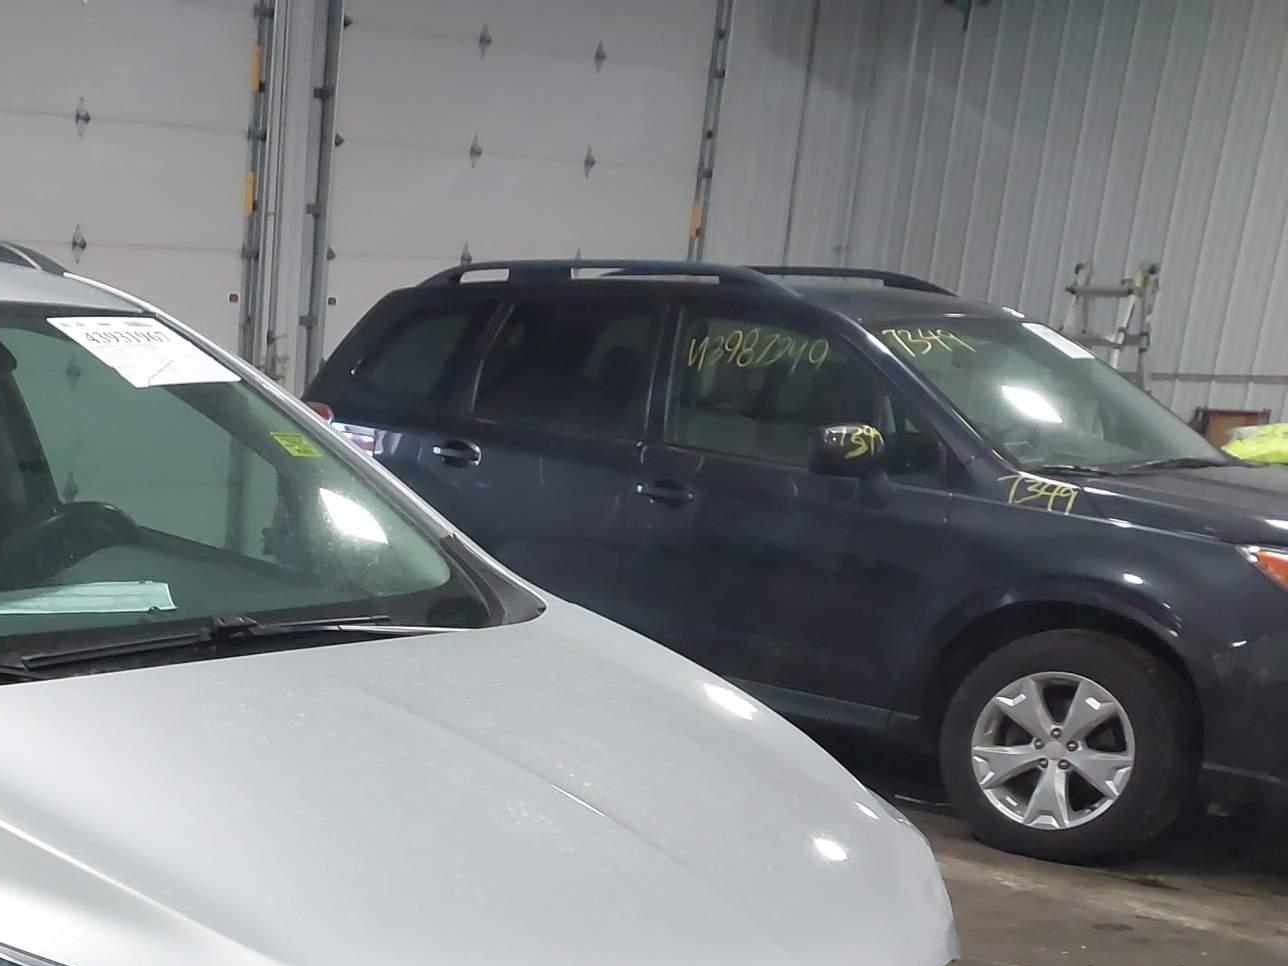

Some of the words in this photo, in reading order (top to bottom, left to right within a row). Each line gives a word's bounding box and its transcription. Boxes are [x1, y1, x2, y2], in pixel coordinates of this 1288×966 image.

[85, 331, 170, 344] 43931967
[881, 328, 977, 357] 7349
[997, 474, 1079, 516] 7349
